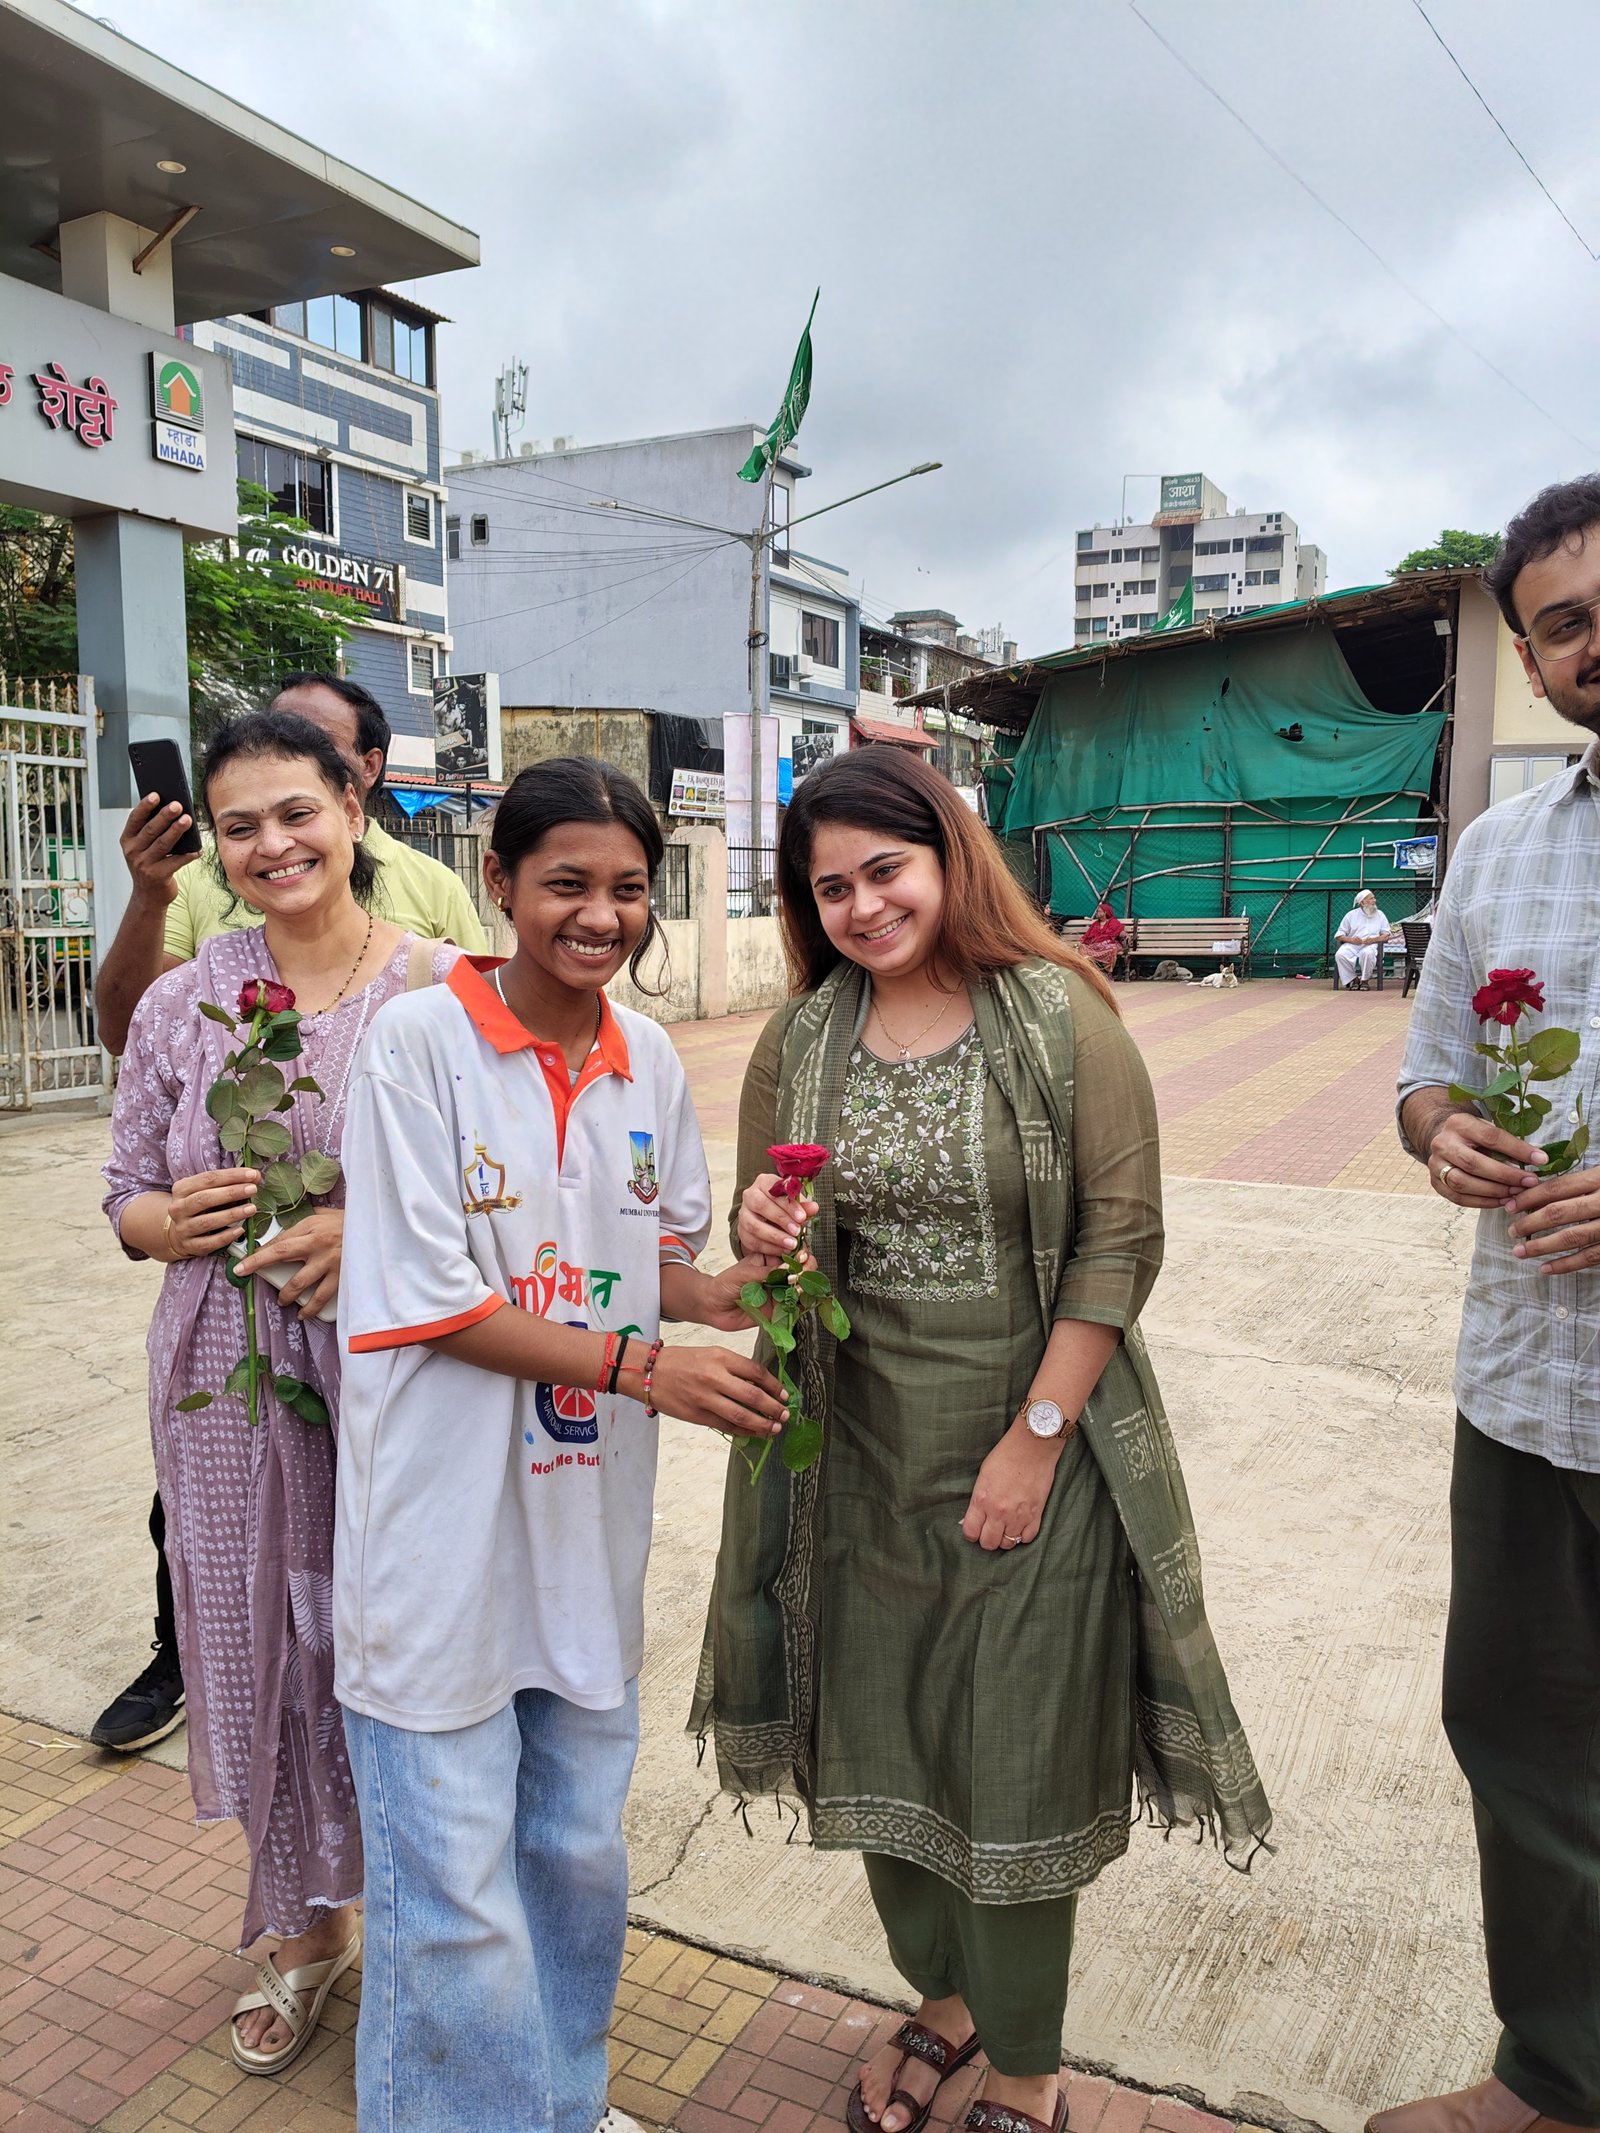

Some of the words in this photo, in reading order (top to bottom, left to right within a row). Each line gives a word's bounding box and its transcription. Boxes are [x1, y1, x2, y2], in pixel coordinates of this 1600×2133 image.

[35, 361, 119, 447] शेट्टी
[166, 427, 197, 448] म्हाडा
[159, 443, 205, 468] MHADA
[1168, 484, 1196, 498] आशा
[282, 544, 369, 587] GOLDEN
[373, 567, 395, 592] 71
[356, 589, 384, 605] HALL
[619, 1207, 643, 1216] MUMBAI
[543, 1399, 562, 1434] NATIONAL
[531, 1460, 554, 1475] Not
[577, 1452, 600, 1467] But
